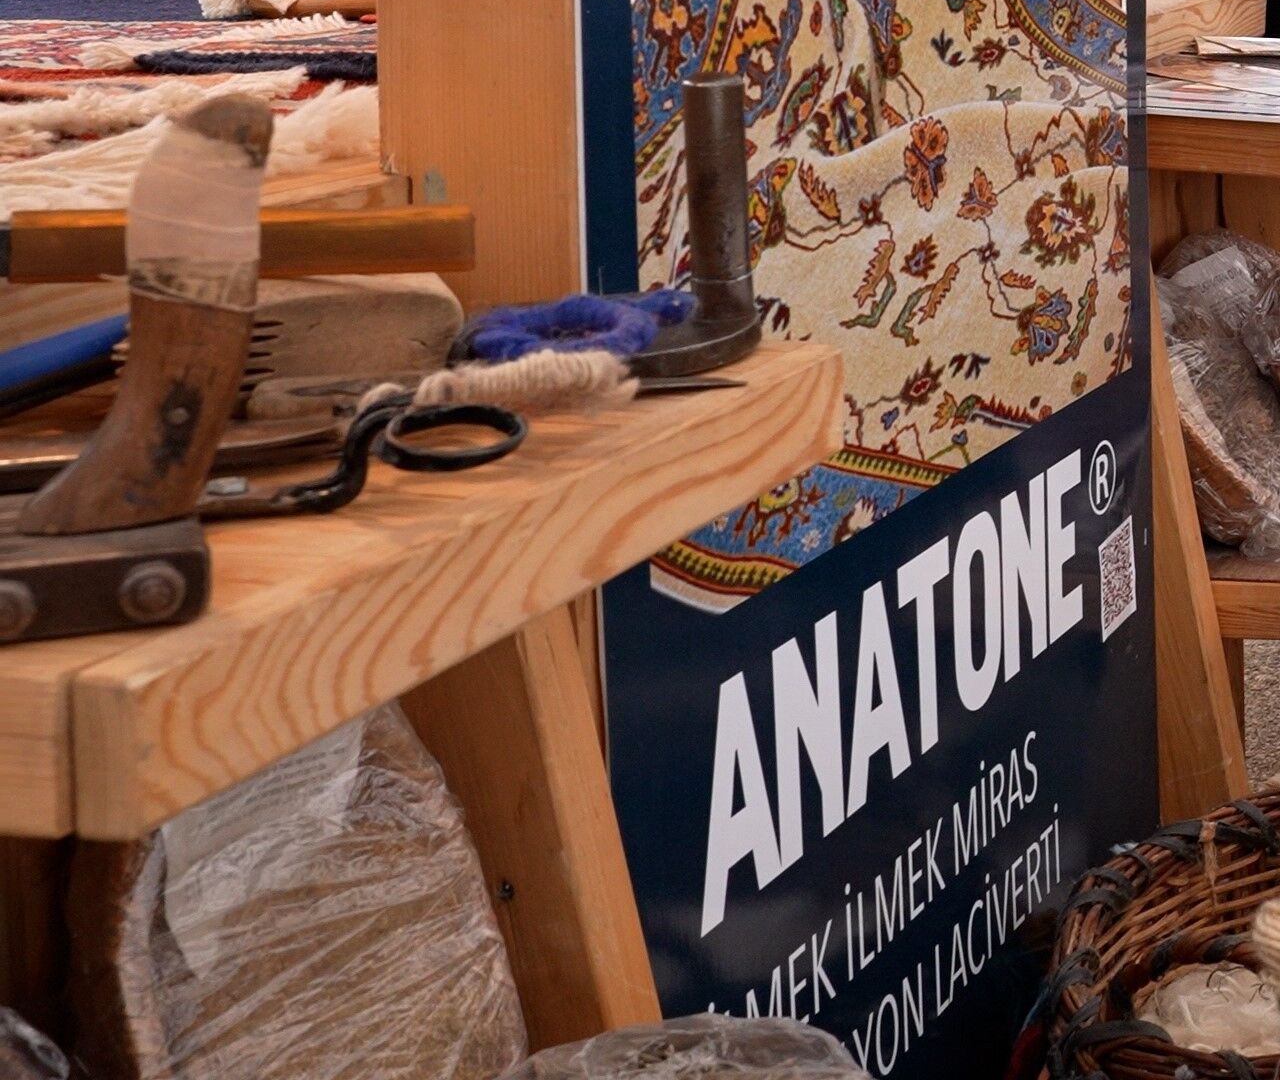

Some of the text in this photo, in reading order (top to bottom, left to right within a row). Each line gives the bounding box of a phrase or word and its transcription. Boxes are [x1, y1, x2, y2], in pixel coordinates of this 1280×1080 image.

[842, 802, 1062, 1076] YON LACİVERTİ
[844, 818, 946, 982] İLMEK
[953, 730, 1039, 877] MİRAS
